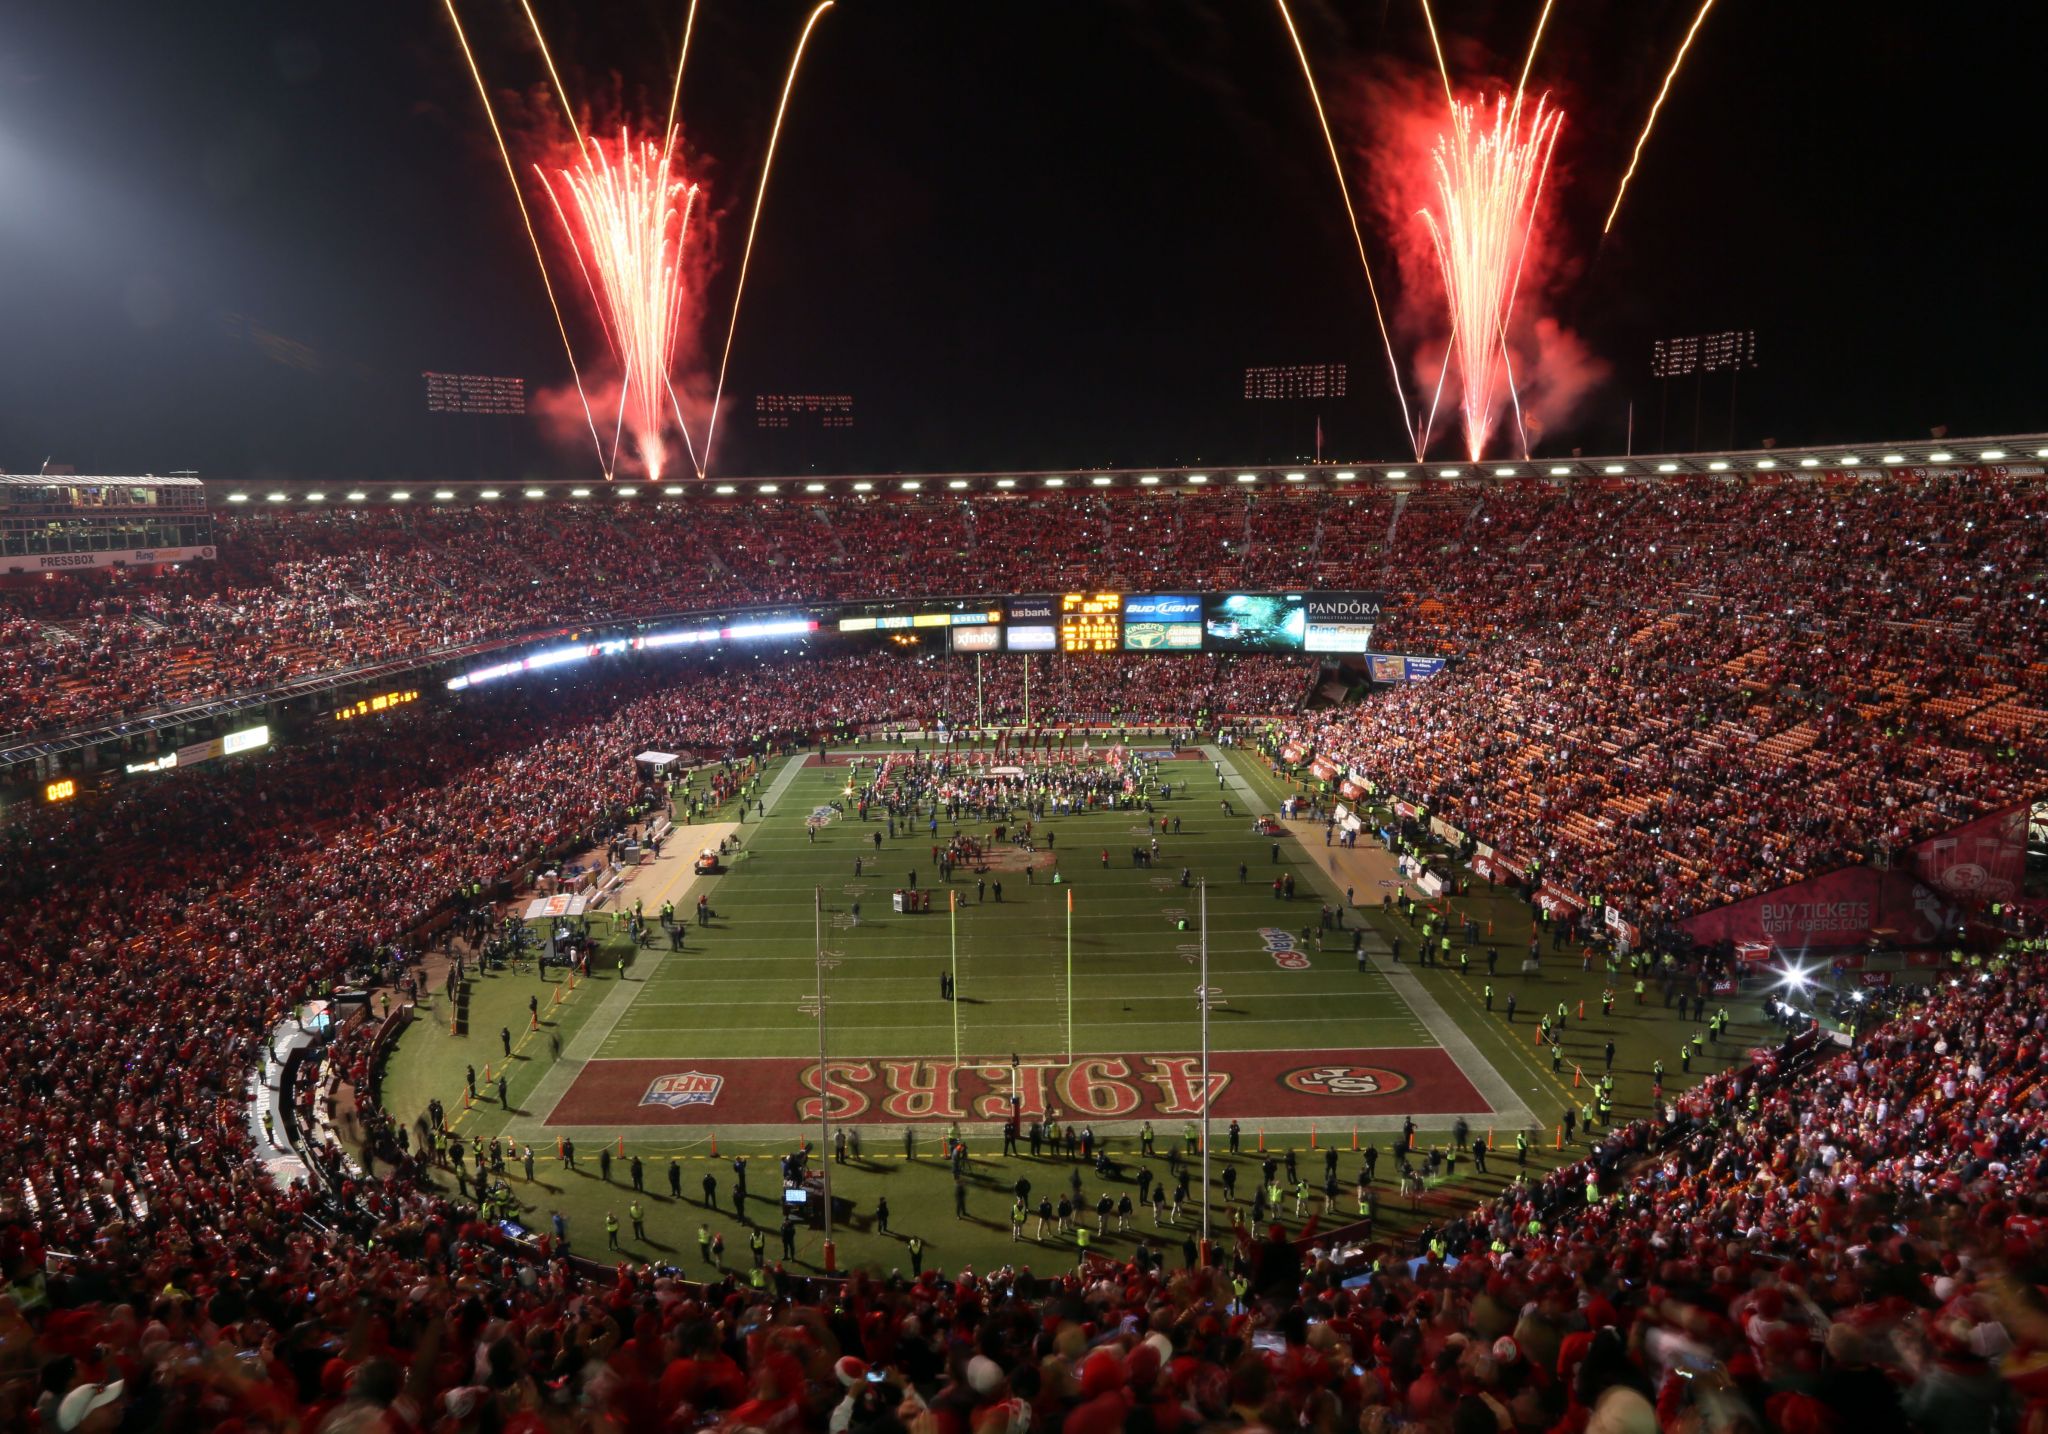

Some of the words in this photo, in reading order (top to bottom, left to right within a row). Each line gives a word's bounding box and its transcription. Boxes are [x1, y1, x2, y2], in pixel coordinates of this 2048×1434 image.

[40, 554, 95, 568] PRESSBOX
[1126, 604, 1156, 613] BUD
[1160, 604, 1200, 613] LIGHT
[883, 617, 908, 628] VISA
[960, 615, 986, 623] DELTA
[957, 632, 997, 647] xfinity
[1761, 903, 1796, 920] BUY
[1800, 901, 1870, 919] TICKETS
[1761, 918, 1793, 933] VISIT
[1797, 916, 1869, 932] 49ERS.COM
[1714, 980, 1731, 991] tick
[659, 1075, 716, 1093] NFL
[797, 1056, 1232, 1120] 49ERS
